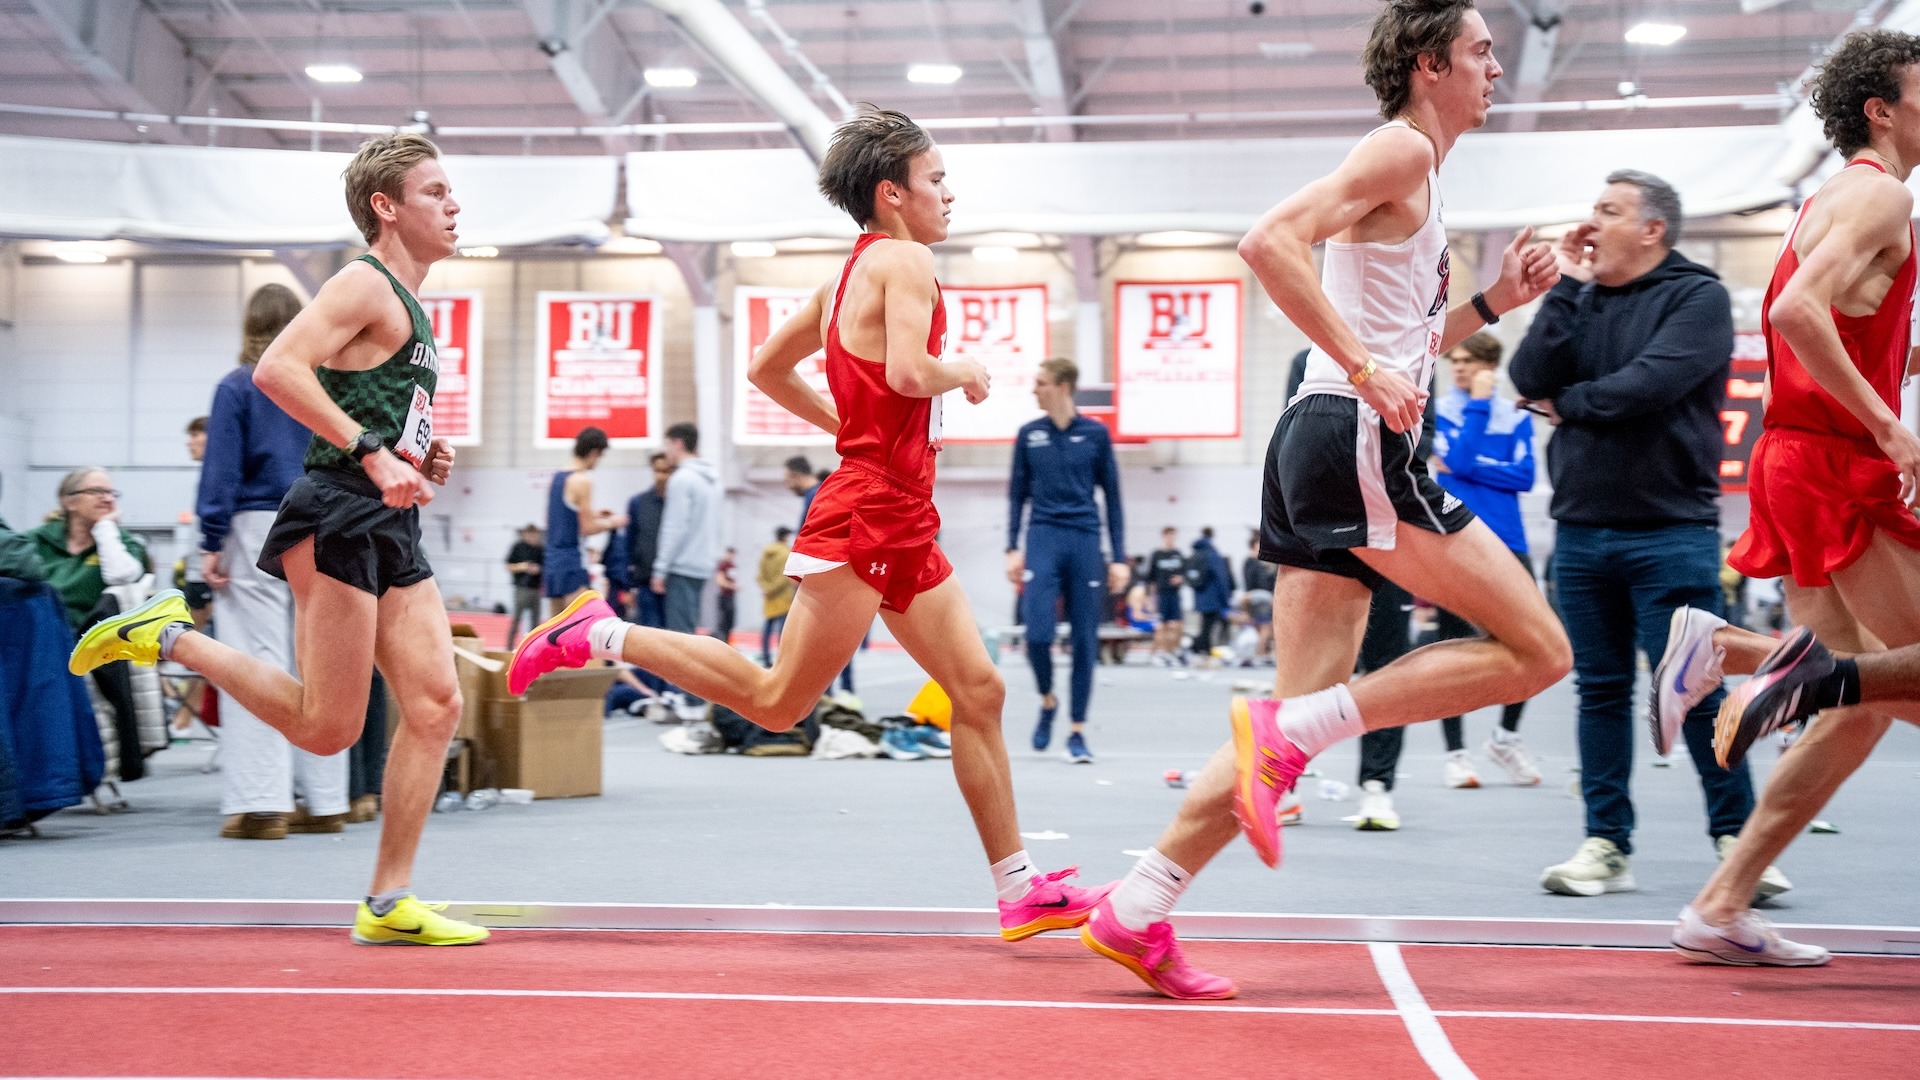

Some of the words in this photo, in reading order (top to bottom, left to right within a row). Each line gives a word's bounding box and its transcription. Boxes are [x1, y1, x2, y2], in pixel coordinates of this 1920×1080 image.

[566, 302, 635, 349] BU
[960, 297, 1018, 343] BU
[1149, 292, 1210, 338] BU
